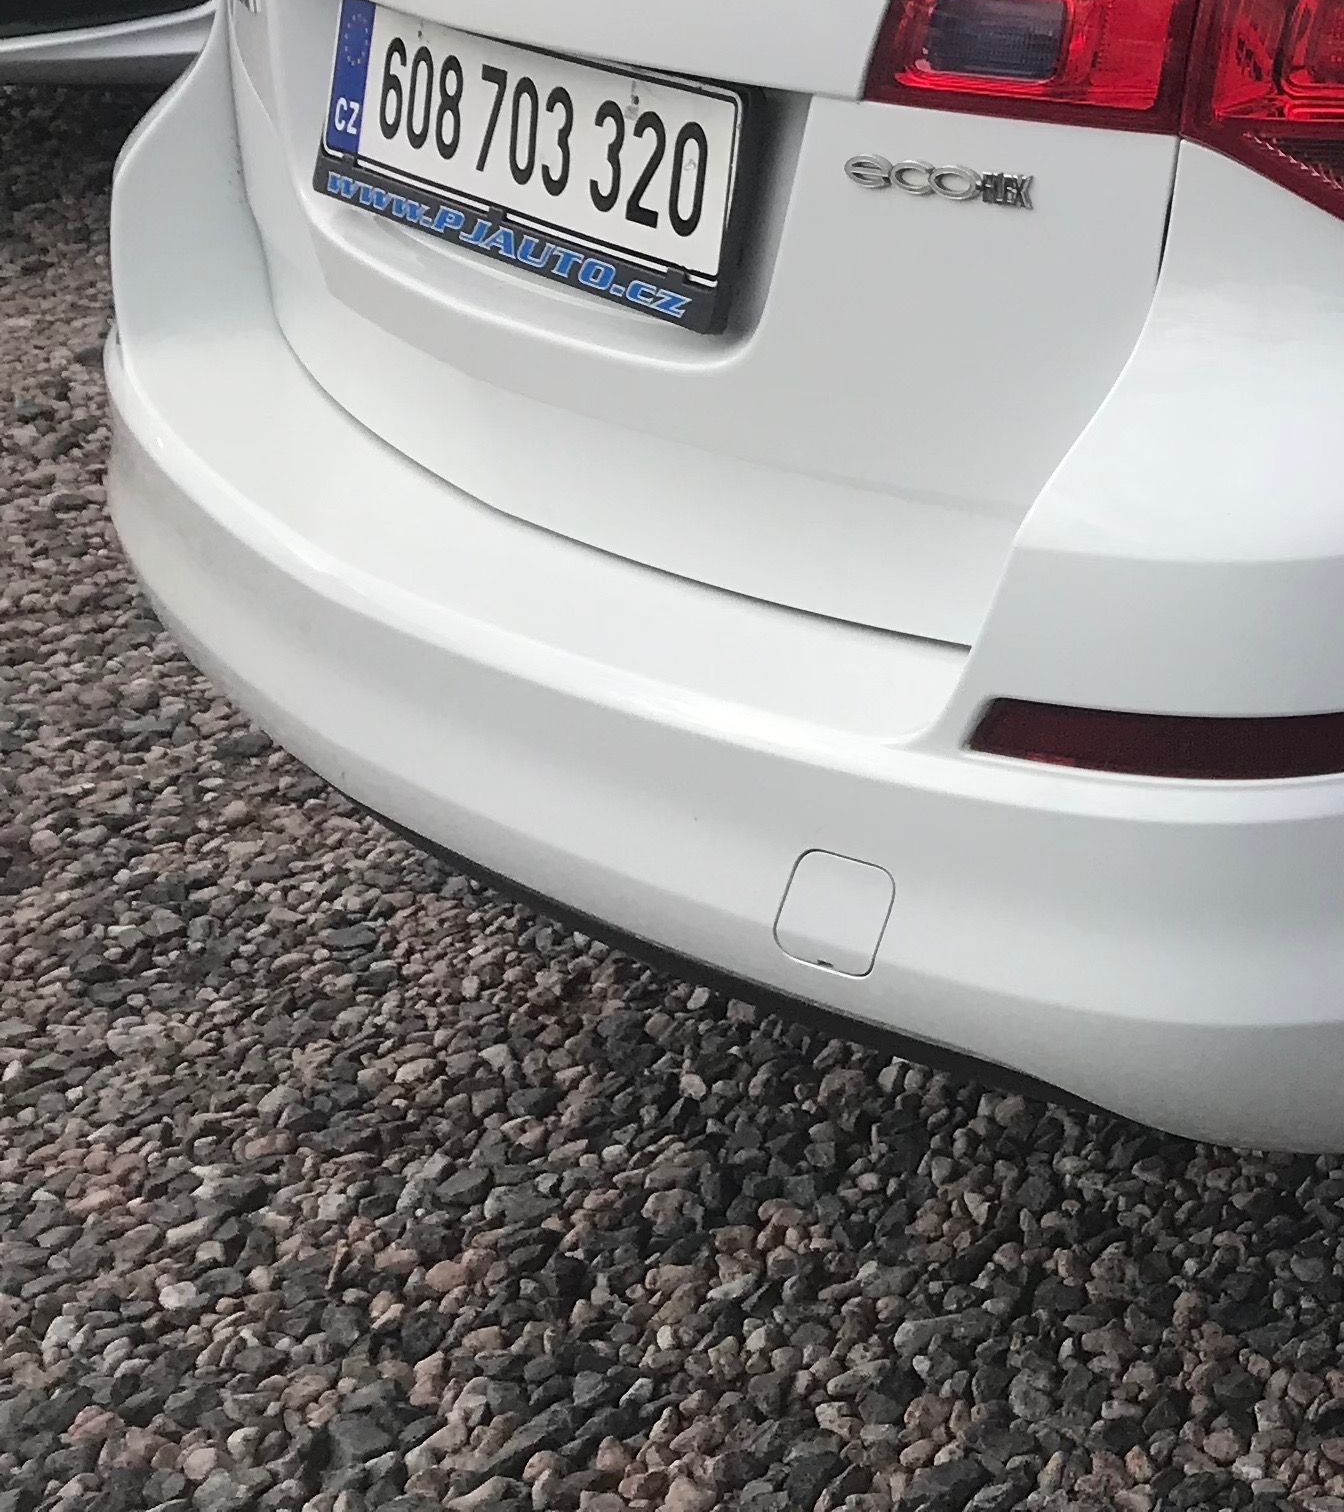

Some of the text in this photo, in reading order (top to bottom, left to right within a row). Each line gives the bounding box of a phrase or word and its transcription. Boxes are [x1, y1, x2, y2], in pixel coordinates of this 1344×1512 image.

[334, 97, 361, 136] CZ
[380, 37, 708, 237] 608 703 320
